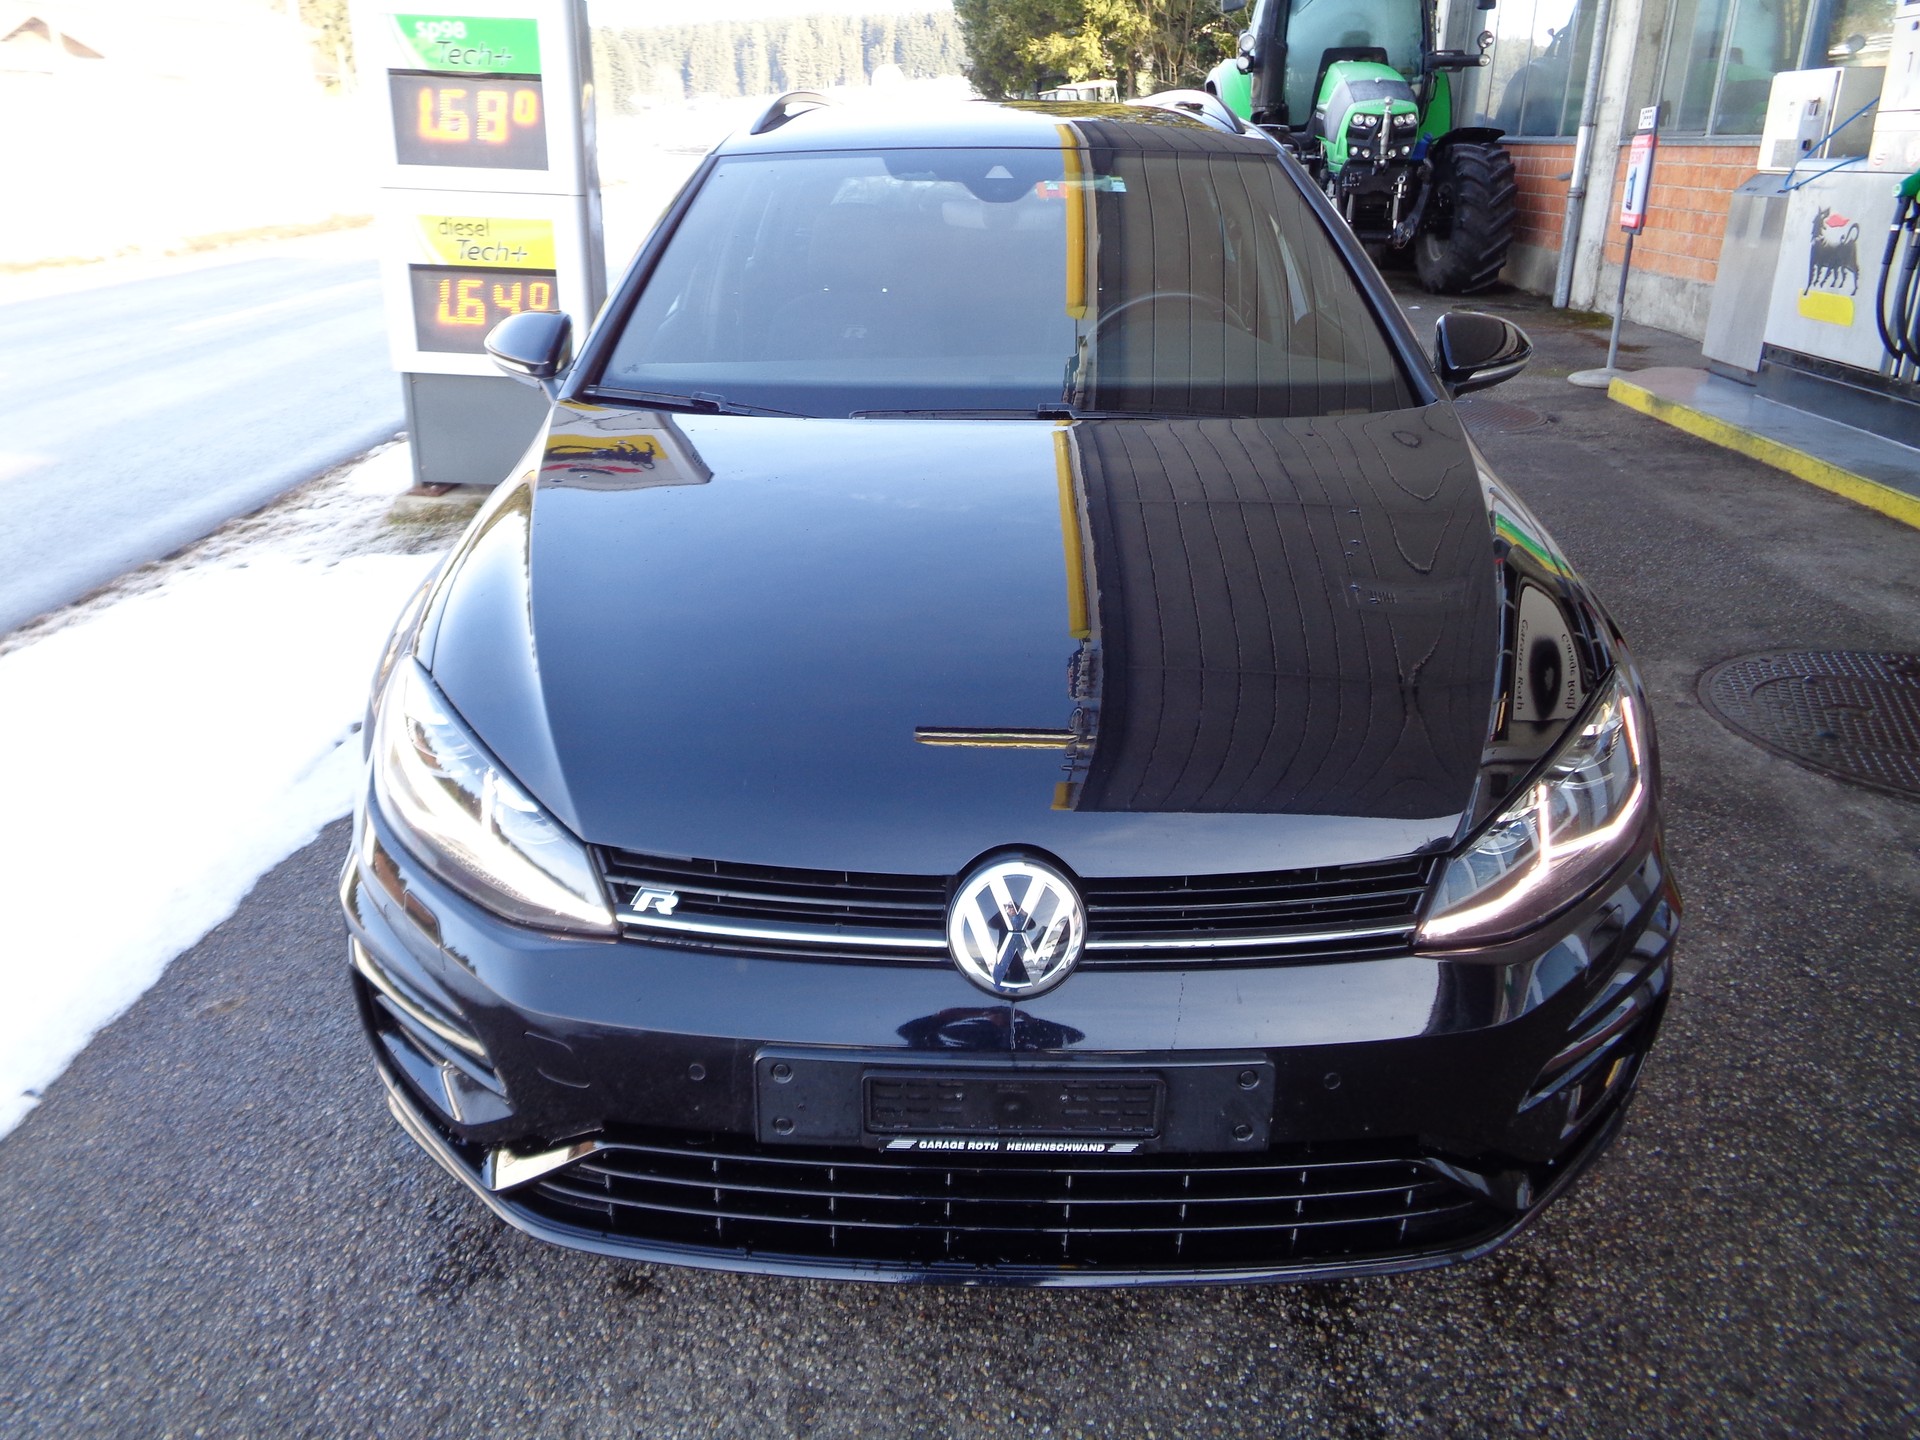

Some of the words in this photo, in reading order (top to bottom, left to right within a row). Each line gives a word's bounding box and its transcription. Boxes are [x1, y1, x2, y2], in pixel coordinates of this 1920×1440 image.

[415, 20, 467, 43] sp98
[436, 40, 512, 66] Tech+
[438, 217, 490, 237] diesel
[455, 239, 528, 263] Tech+
[630, 886, 679, 916] R
[919, 1141, 965, 1150] GARAGE
[967, 1142, 999, 1151] ROTH
[1006, 1143, 1105, 1152] HEIMENSCHWAND
